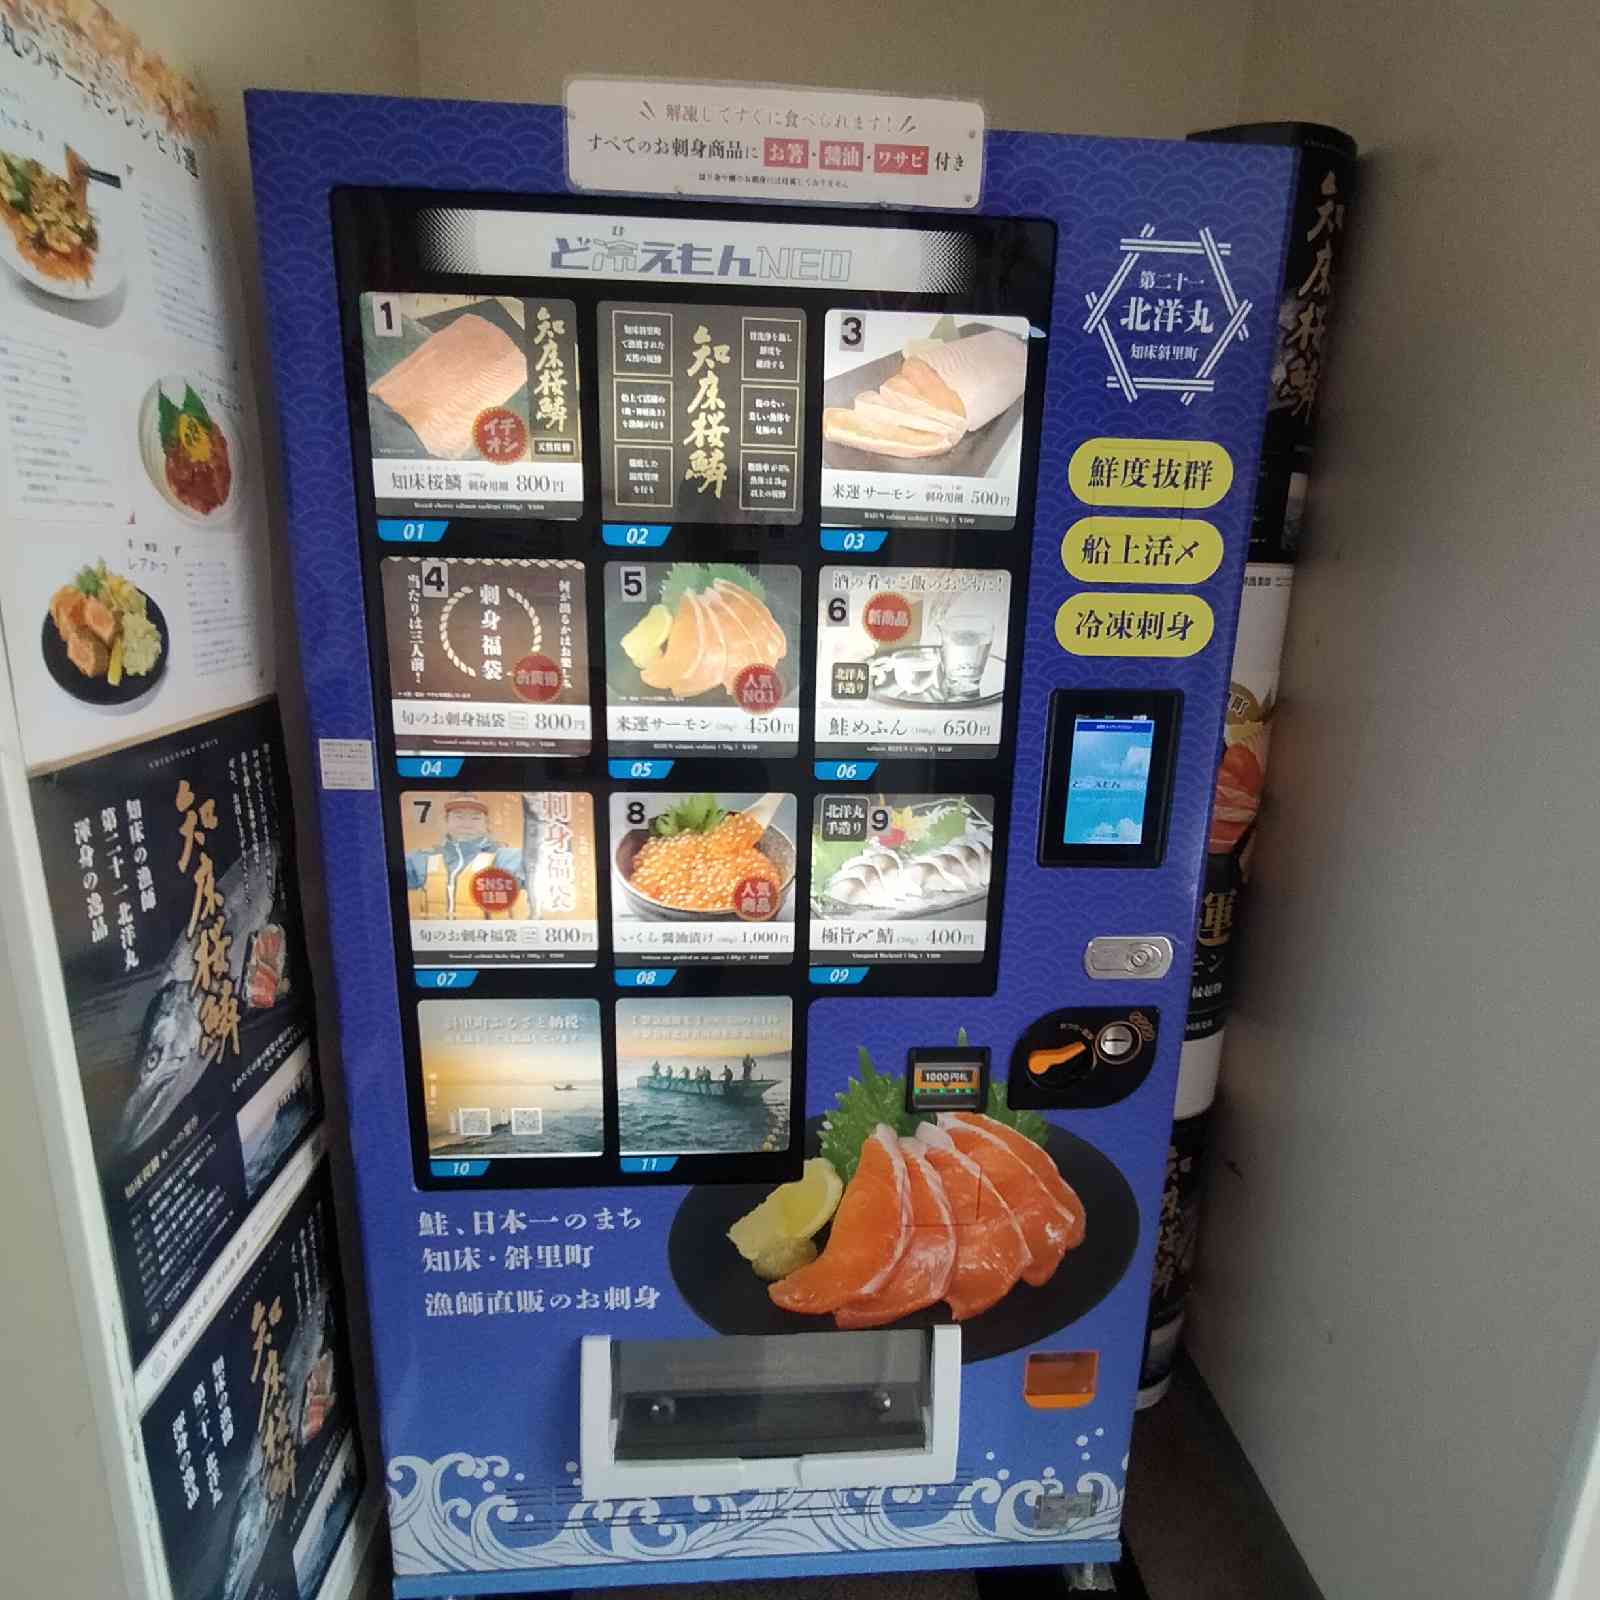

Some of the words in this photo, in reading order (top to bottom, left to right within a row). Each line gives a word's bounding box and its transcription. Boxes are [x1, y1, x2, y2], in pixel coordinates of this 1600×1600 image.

[879, 152, 922, 168] ワサビ
[936, 152, 965, 171] 付き
[1139, 271, 1205, 291] 第二十一
[379, 301, 393, 330] 1
[1120, 297, 1214, 334] 北洋丸
[841, 317, 861, 346] 3
[1131, 344, 1199, 362] 知床斜里町
[1088, 456, 1214, 491] 鮮度抜群
[515, 475, 566, 494] 800円
[971, 491, 1011, 506] 500円
[403, 523, 425, 541] 01
[625, 527, 649, 545] 02
[843, 532, 865, 550] 03
[1082, 535, 1200, 567] 船上活〆
[424, 566, 445, 592] 4
[624, 571, 642, 596] 5
[828, 598, 846, 622] 6
[480, 584, 503, 681] 刺身福袋
[1075, 610, 1194, 641] 冷凍刺身
[401, 710, 505, 729] 旬のお刺身福袋
[535, 713, 586, 732] 800円
[748, 717, 794, 735] 450円
[943, 719, 991, 737] 650円
[420, 761, 443, 777] 04
[630, 762, 652, 778] 05
[836, 764, 857, 779] 06
[413, 801, 432, 824] 7
[627, 802, 645, 825] 8
[825, 805, 865, 819] 北洋丸
[871, 809, 889, 832] 9
[419, 928, 518, 944] 旬のお刺身福袋
[545, 927, 594, 944] 800円
[926, 928, 974, 946] 400円
[436, 973, 457, 987] 07
[636, 971, 657, 986] 08
[829, 970, 850, 983] 09
[453, 1162, 470, 1175] 10
[642, 1158, 658, 1170] 11
[418, 1207, 642, 1237] 鮭、日本一のまち
[422, 1243, 595, 1273] 知床・斜里町
[424, 1285, 661, 1317] 漁師直販のお刺身
